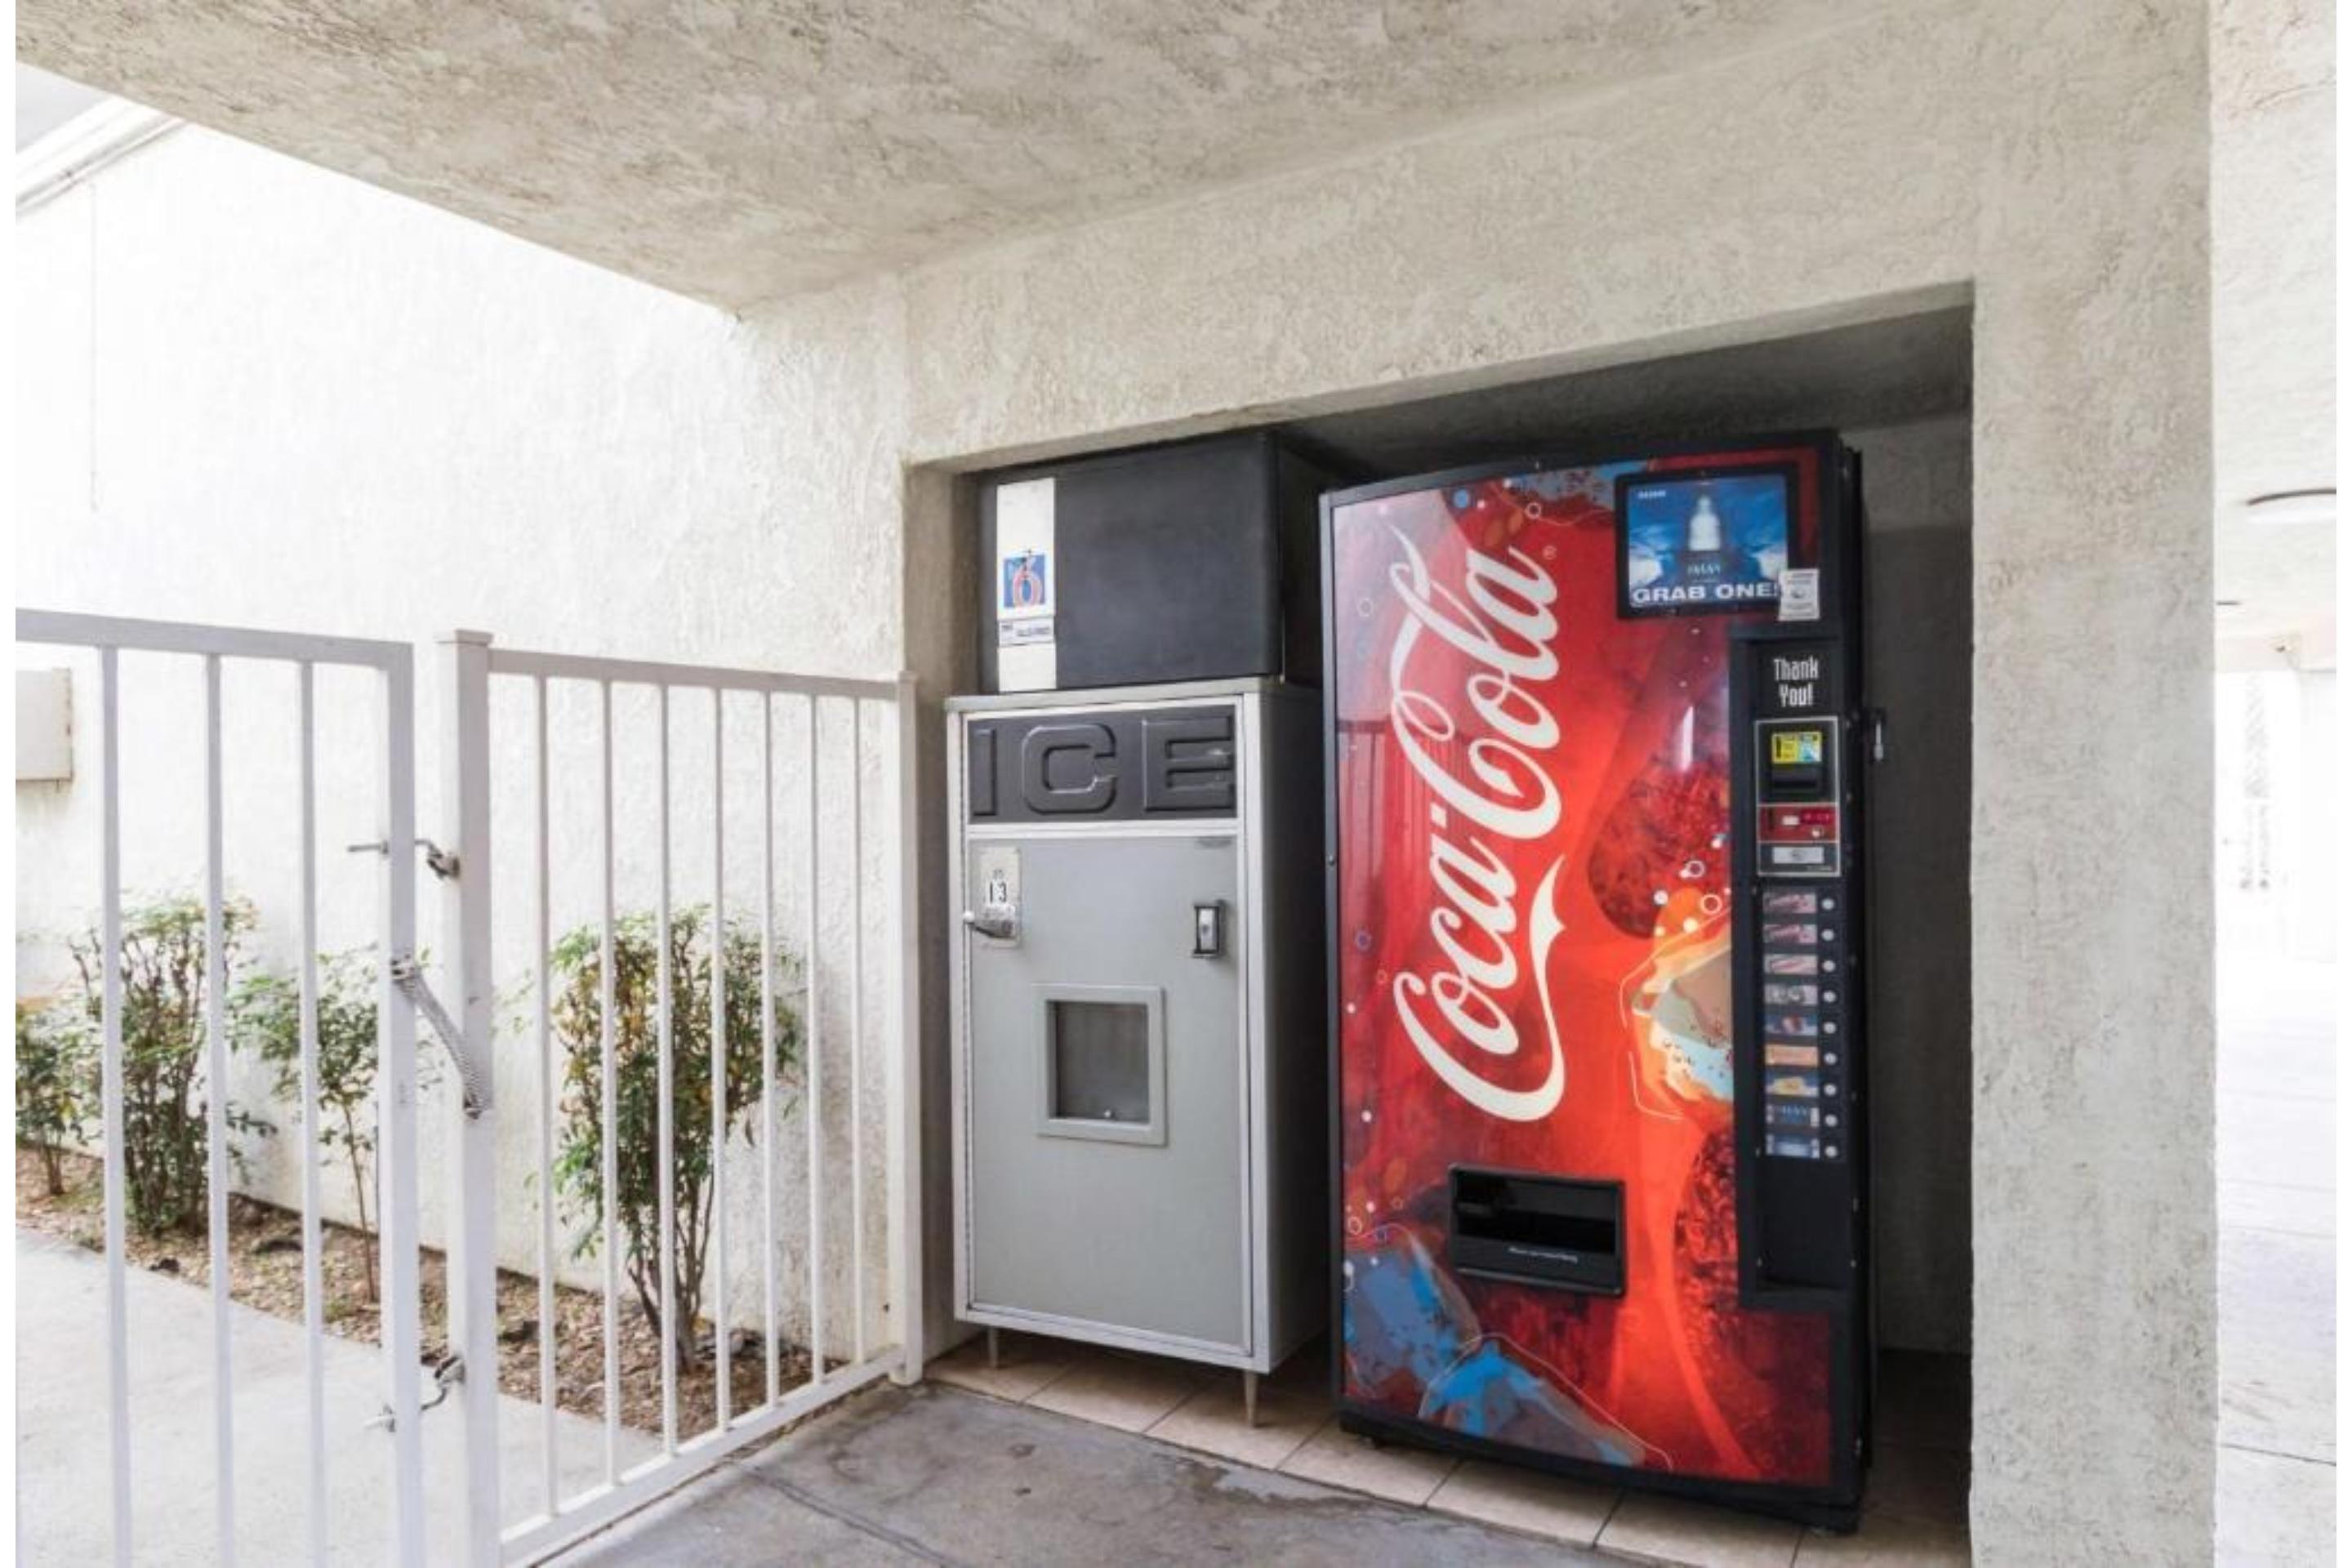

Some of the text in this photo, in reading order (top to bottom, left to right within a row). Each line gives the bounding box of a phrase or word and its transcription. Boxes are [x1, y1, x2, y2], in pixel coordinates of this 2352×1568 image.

[1633, 585, 1707, 604] GRAB
[1773, 656, 1819, 681] Thank
[1779, 684, 1814, 707] You!
[972, 714, 1236, 816] ICE
[1388, 523, 1566, 1123] Coca-Cola
